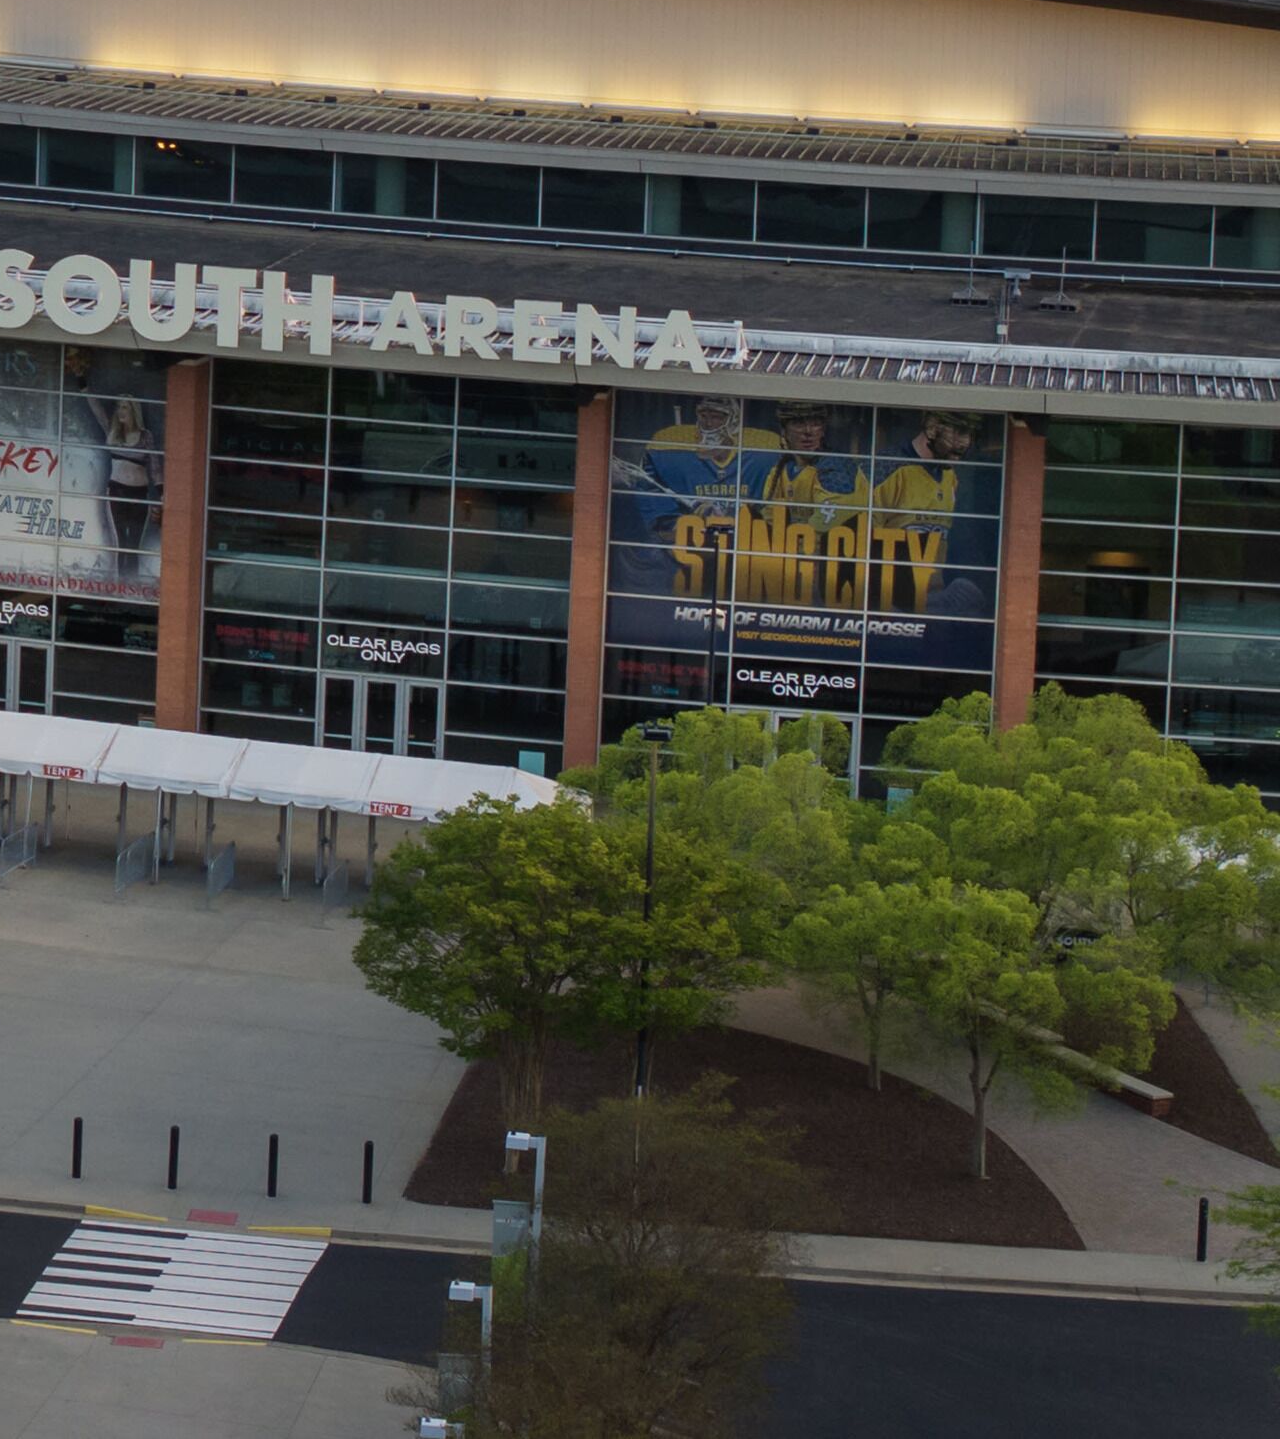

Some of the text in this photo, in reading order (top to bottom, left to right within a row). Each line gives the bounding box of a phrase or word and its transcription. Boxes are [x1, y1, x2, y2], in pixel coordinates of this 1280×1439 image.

[369, 291, 711, 375] ARENA
[27, 516, 86, 540] HERE
[672, 502, 942, 614] STING CITY
[2, 601, 49, 617] BAGS
[734, 611, 758, 625] OF
[759, 612, 831, 631] SWARM
[832, 619, 926, 638] LACROSSE
[736, 630, 760, 641] VISIT
[326, 634, 441, 656] CLEAR BAGS
[360, 649, 406, 664] ONLY
[736, 669, 856, 689] CLEAR BAGS
[772, 684, 821, 699] ONLY
[45, 765, 82, 778] TENT 2
[372, 802, 410, 816] TENT 2
